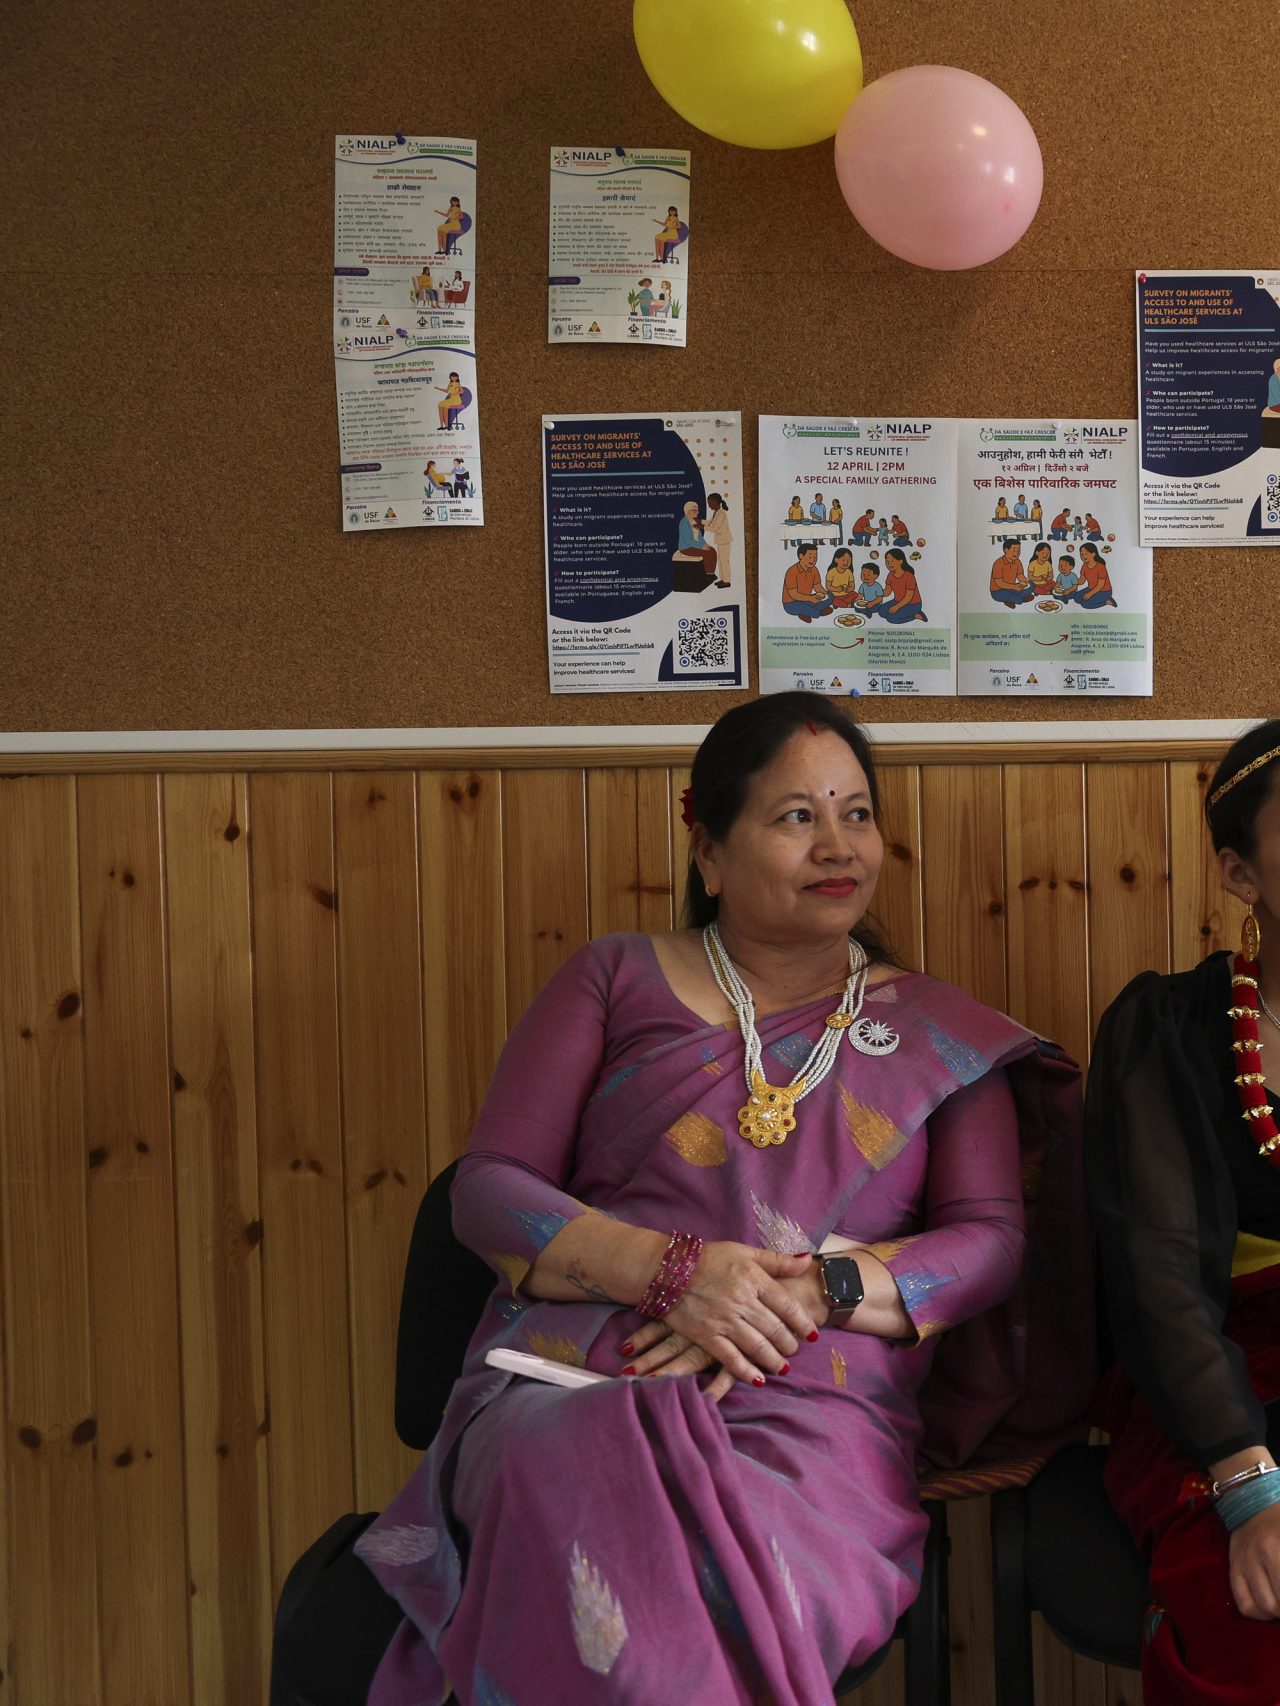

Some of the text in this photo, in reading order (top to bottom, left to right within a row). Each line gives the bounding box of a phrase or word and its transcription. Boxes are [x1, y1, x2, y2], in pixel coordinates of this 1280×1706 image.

[357, 140, 396, 149] NIALP
[572, 151, 612, 161] NIALP
[1161, 316, 1177, 325] SÃO
[354, 335, 394, 346] NIALP
[886, 424, 932, 434] NIALP
[1083, 427, 1128, 437] NIALP
[551, 433, 641, 442] SURVEY ON MIGRANTS'
[551, 443, 582, 451] ACCESS
[596, 442, 613, 450] AND
[551, 452, 601, 460] HEALTHCARE
[603, 451, 640, 459] SERVICES
[824, 447, 902, 456] LET'S REUNITE
[568, 460, 585, 469] SÃO
[826, 462, 905, 471] 12 APRIL 2PM
[795, 476, 937, 485] A SPECIAL FAMILY GATHERING
